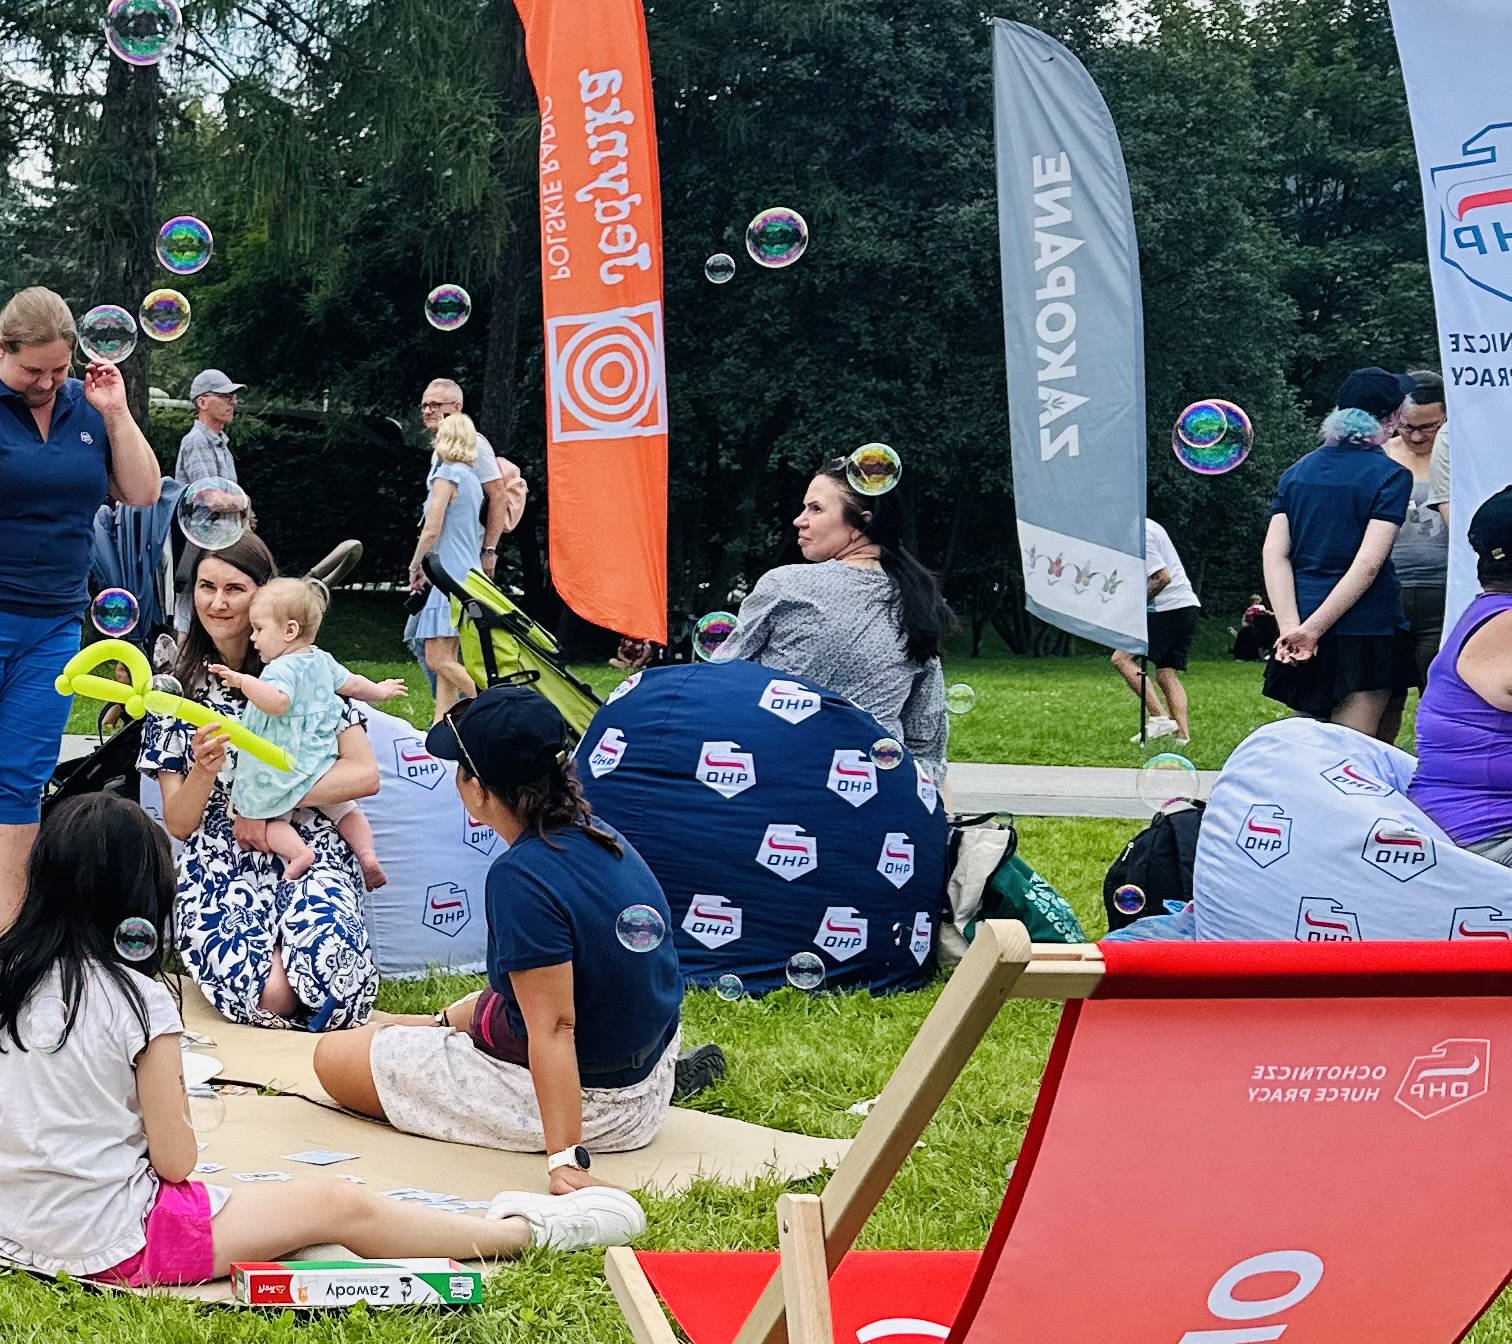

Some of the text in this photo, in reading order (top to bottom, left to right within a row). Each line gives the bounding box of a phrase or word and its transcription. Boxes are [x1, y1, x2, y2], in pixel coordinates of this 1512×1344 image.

[771, 698, 813, 711] OHP
[592, 753, 616, 766] OHP
[408, 763, 439, 777] OHP
[706, 771, 748, 784] OHP
[1332, 775, 1379, 792] OHP
[838, 780, 872, 793] OHP
[472, 828, 494, 844] OHP
[1245, 836, 1282, 852] OHP
[767, 854, 810, 868] OHP
[1376, 850, 1426, 865] OHP
[885, 862, 910, 875] OHP
[433, 909, 465, 925] OHP
[691, 922, 734, 936] OHP
[824, 936, 862, 949] OHP
[326, 1282, 390, 1300] Zawody
